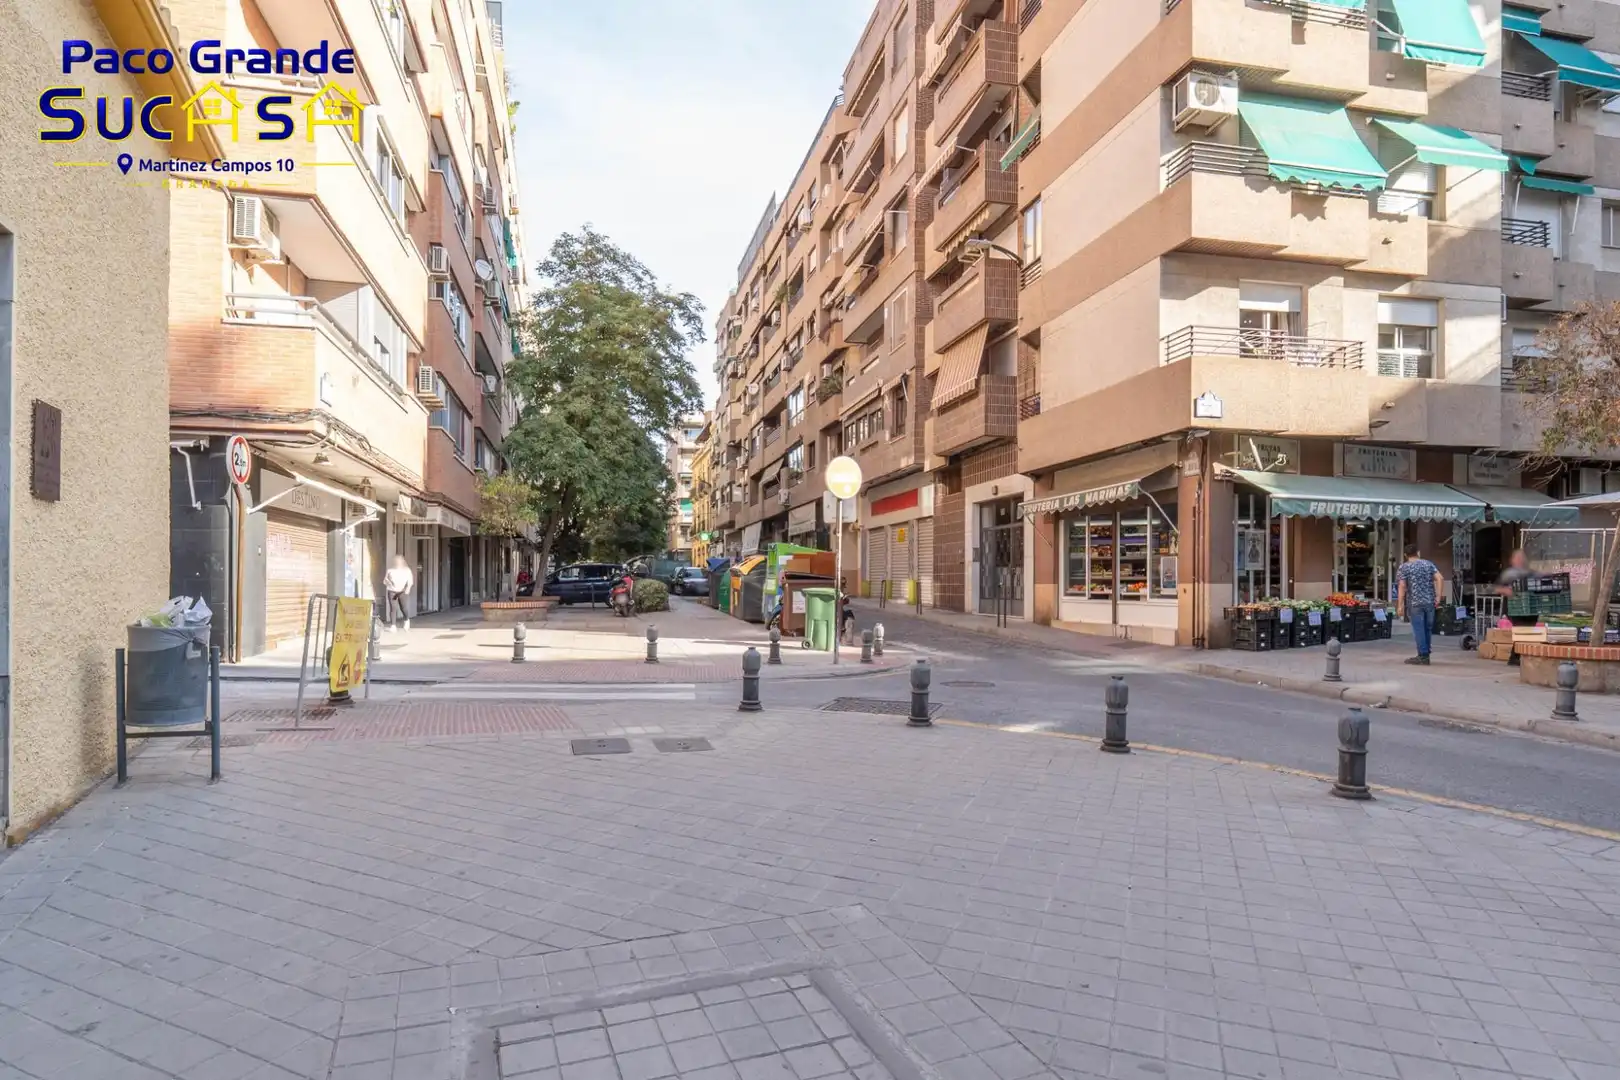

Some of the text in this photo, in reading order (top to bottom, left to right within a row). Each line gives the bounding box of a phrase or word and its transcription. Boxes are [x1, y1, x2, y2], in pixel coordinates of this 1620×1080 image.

[291, 487, 321, 511] DESTINO
[1022, 483, 1132, 514] FRUTERIA LAS MARINAS
[1309, 501, 1460, 518] FRUTERIA LAS MARINAS
